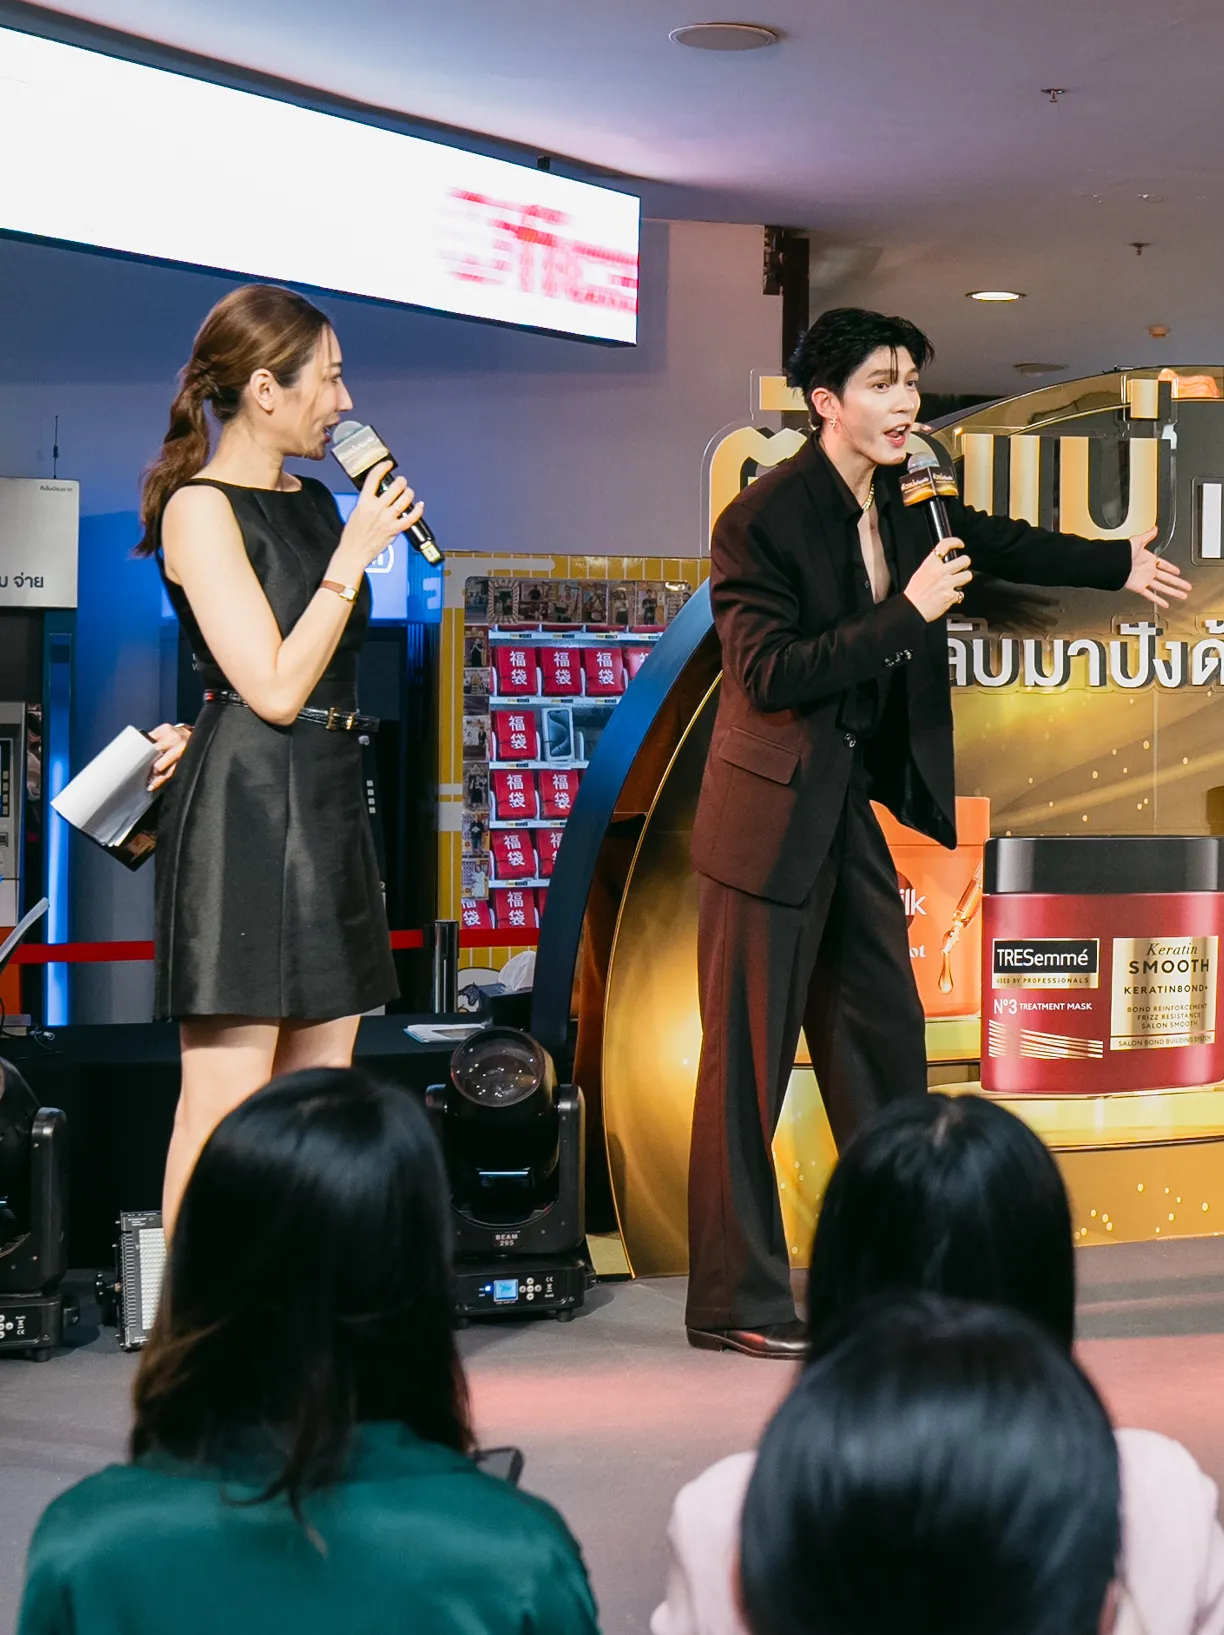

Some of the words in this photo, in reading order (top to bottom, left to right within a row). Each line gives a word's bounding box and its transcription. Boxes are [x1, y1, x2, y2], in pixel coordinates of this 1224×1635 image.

[13, 572, 44, 588] จ่าย
[509, 651, 527, 686] 福袋
[554, 651, 572, 686] 福袋
[597, 652, 615, 686] 福袋
[509, 715, 527, 750] 福袋
[507, 774, 526, 808] 福袋
[553, 774, 571, 809] 福袋
[504, 835, 525, 866] 福袋
[507, 891, 526, 926] 福袋
[899, 888, 928, 916] ilk
[997, 948, 1089, 968] TRESemmé
[1146, 943, 1198, 956] Keratin
[1129, 959, 1210, 975] SMOOTH
[1019, 1003, 1066, 1011] TREATMENT
[1067, 1002, 1093, 1011] MASK
[1137, 1013, 1160, 1021] FRIZZ
[1161, 1012, 1201, 1020] RESISTANCE
[1153, 1003, 1208, 1012] REINFORCEMENT
[1169, 1020, 1198, 1028] SMOOTH
[1118, 1039, 1143, 1047] SALON
[1165, 1037, 1191, 1045] BUILDING
